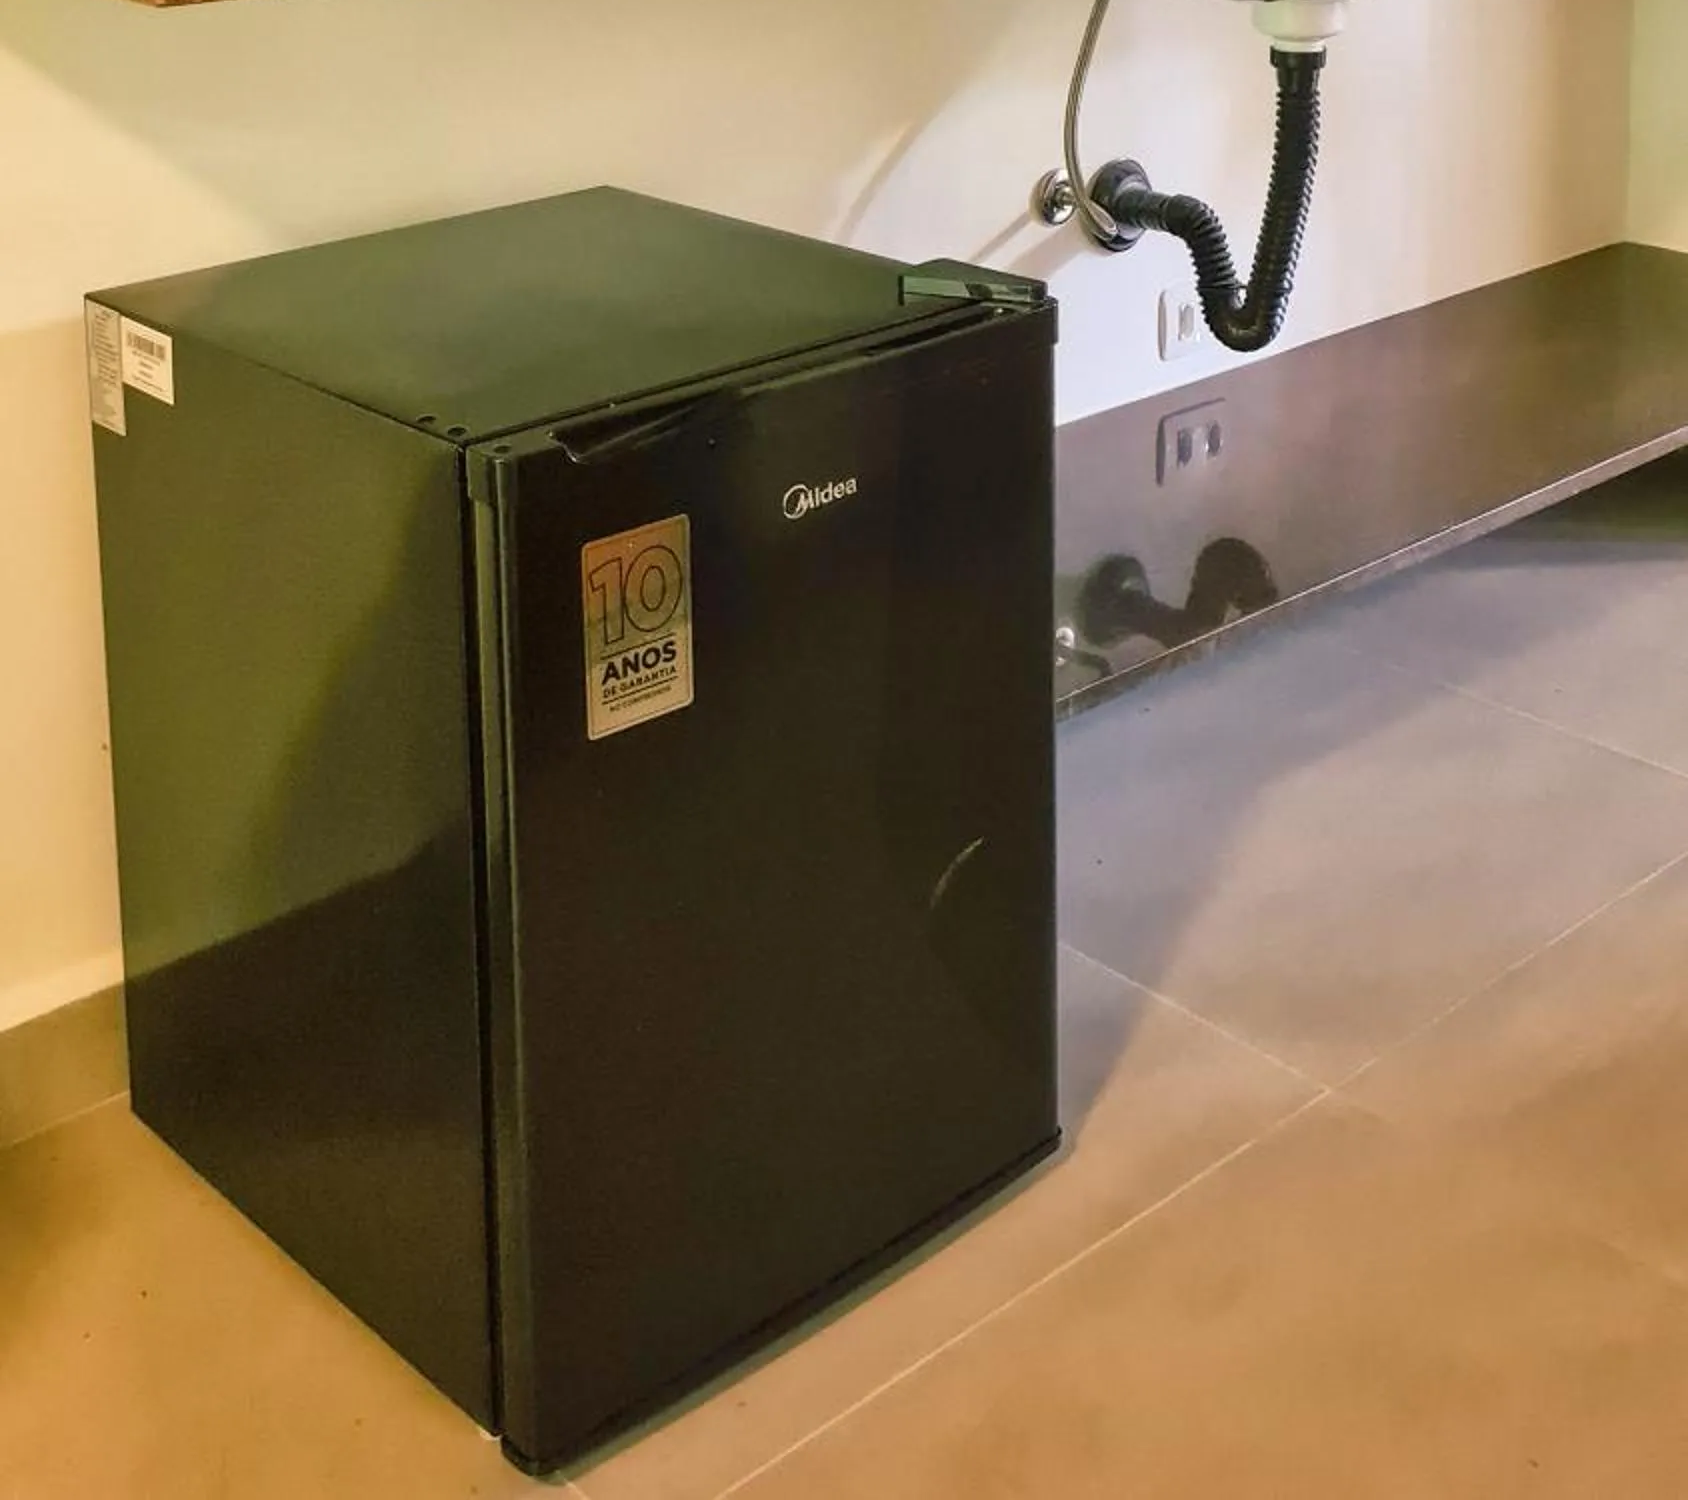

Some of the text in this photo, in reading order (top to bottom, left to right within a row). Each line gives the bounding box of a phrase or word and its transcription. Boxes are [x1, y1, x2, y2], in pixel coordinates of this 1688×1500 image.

[783, 478, 857, 519] Midea
[589, 544, 683, 645] 10
[601, 640, 677, 686] ANOS
[603, 665, 677, 699] DE GARANTIA
